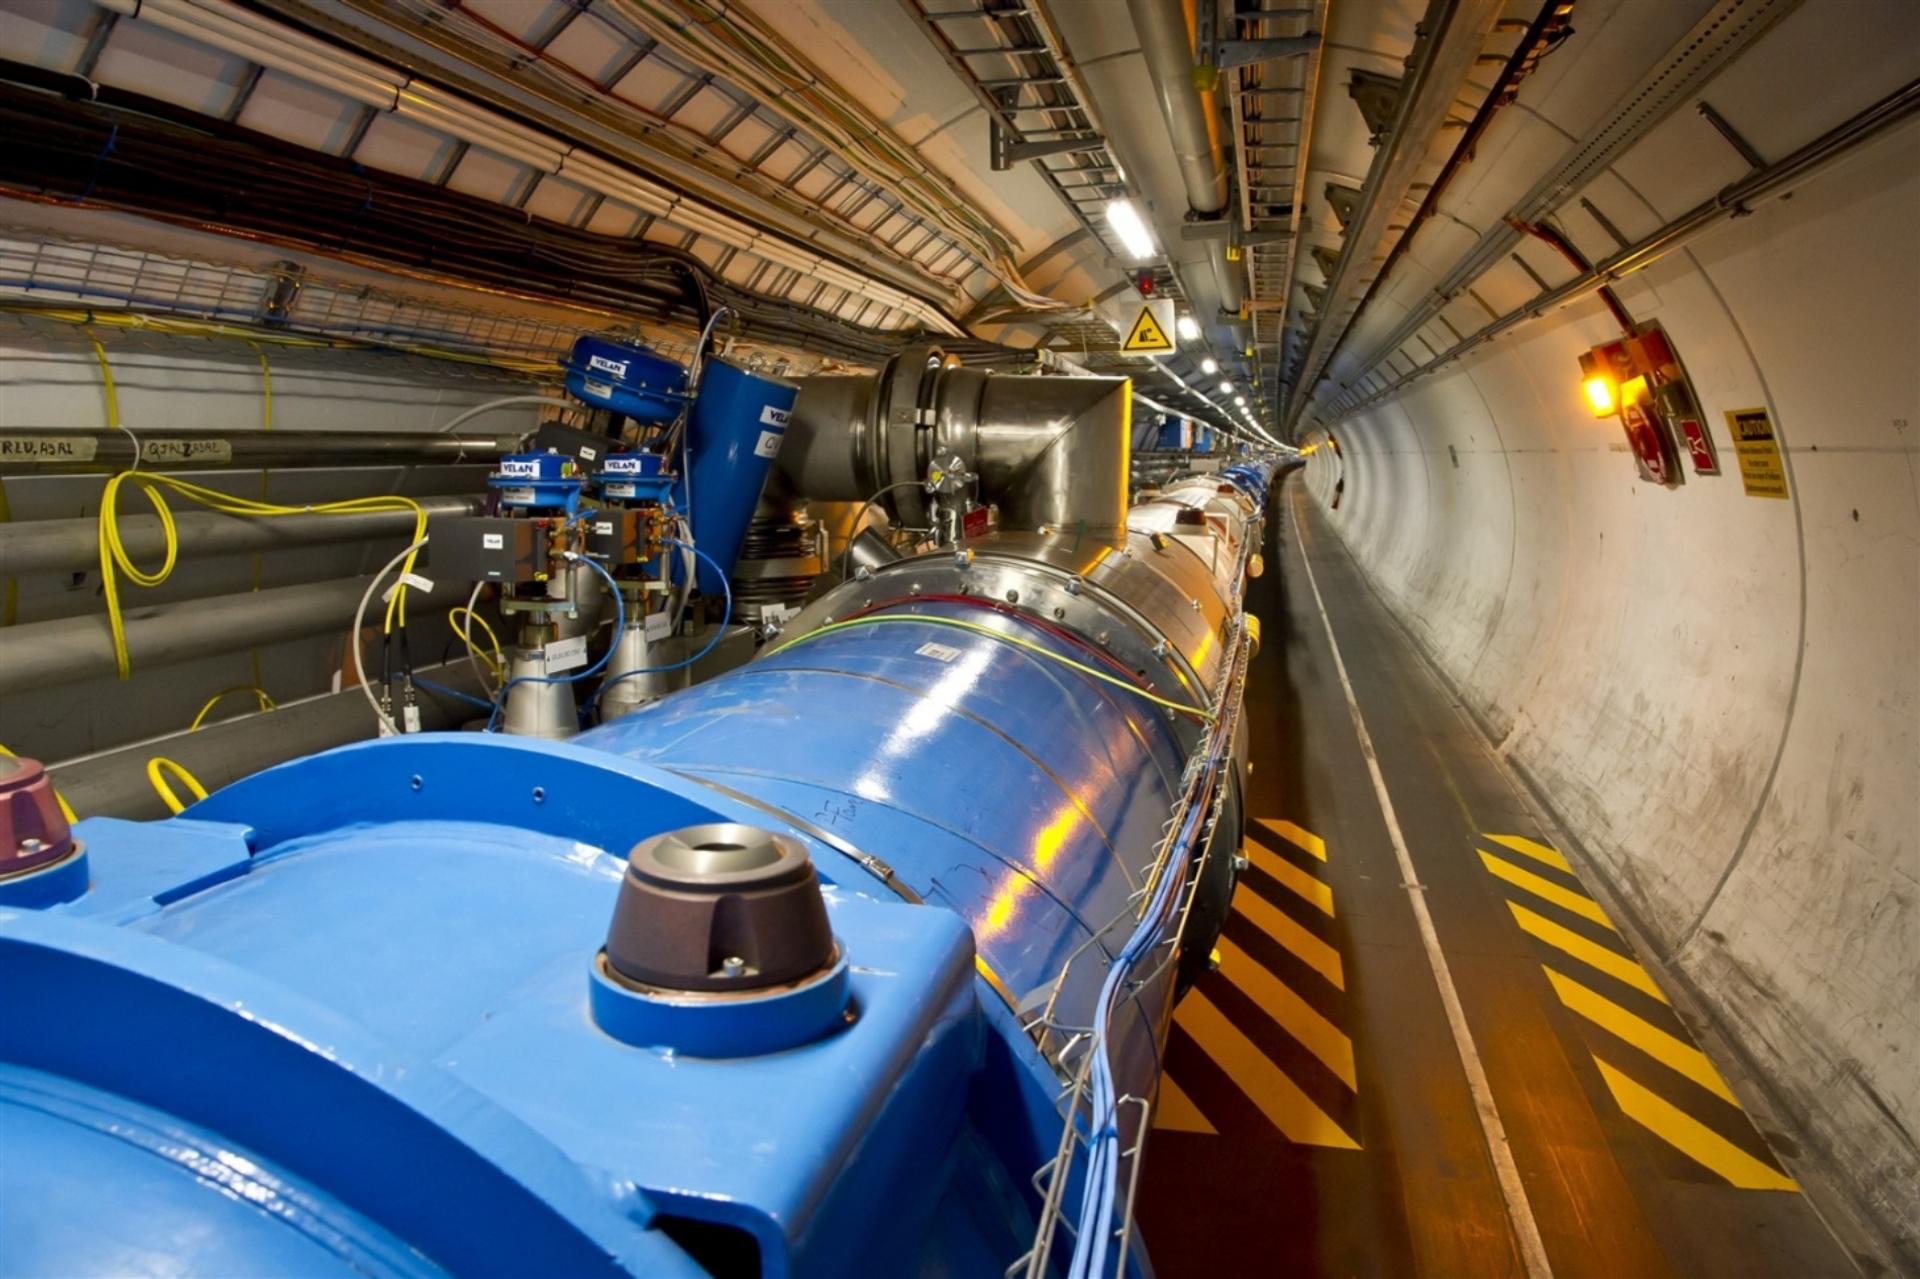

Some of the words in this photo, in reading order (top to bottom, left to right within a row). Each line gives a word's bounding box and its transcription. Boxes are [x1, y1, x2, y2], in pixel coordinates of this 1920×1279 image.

[595, 359, 621, 371] VELAN
[503, 463, 534, 473] VELAN
[607, 462, 636, 470] VELAN
